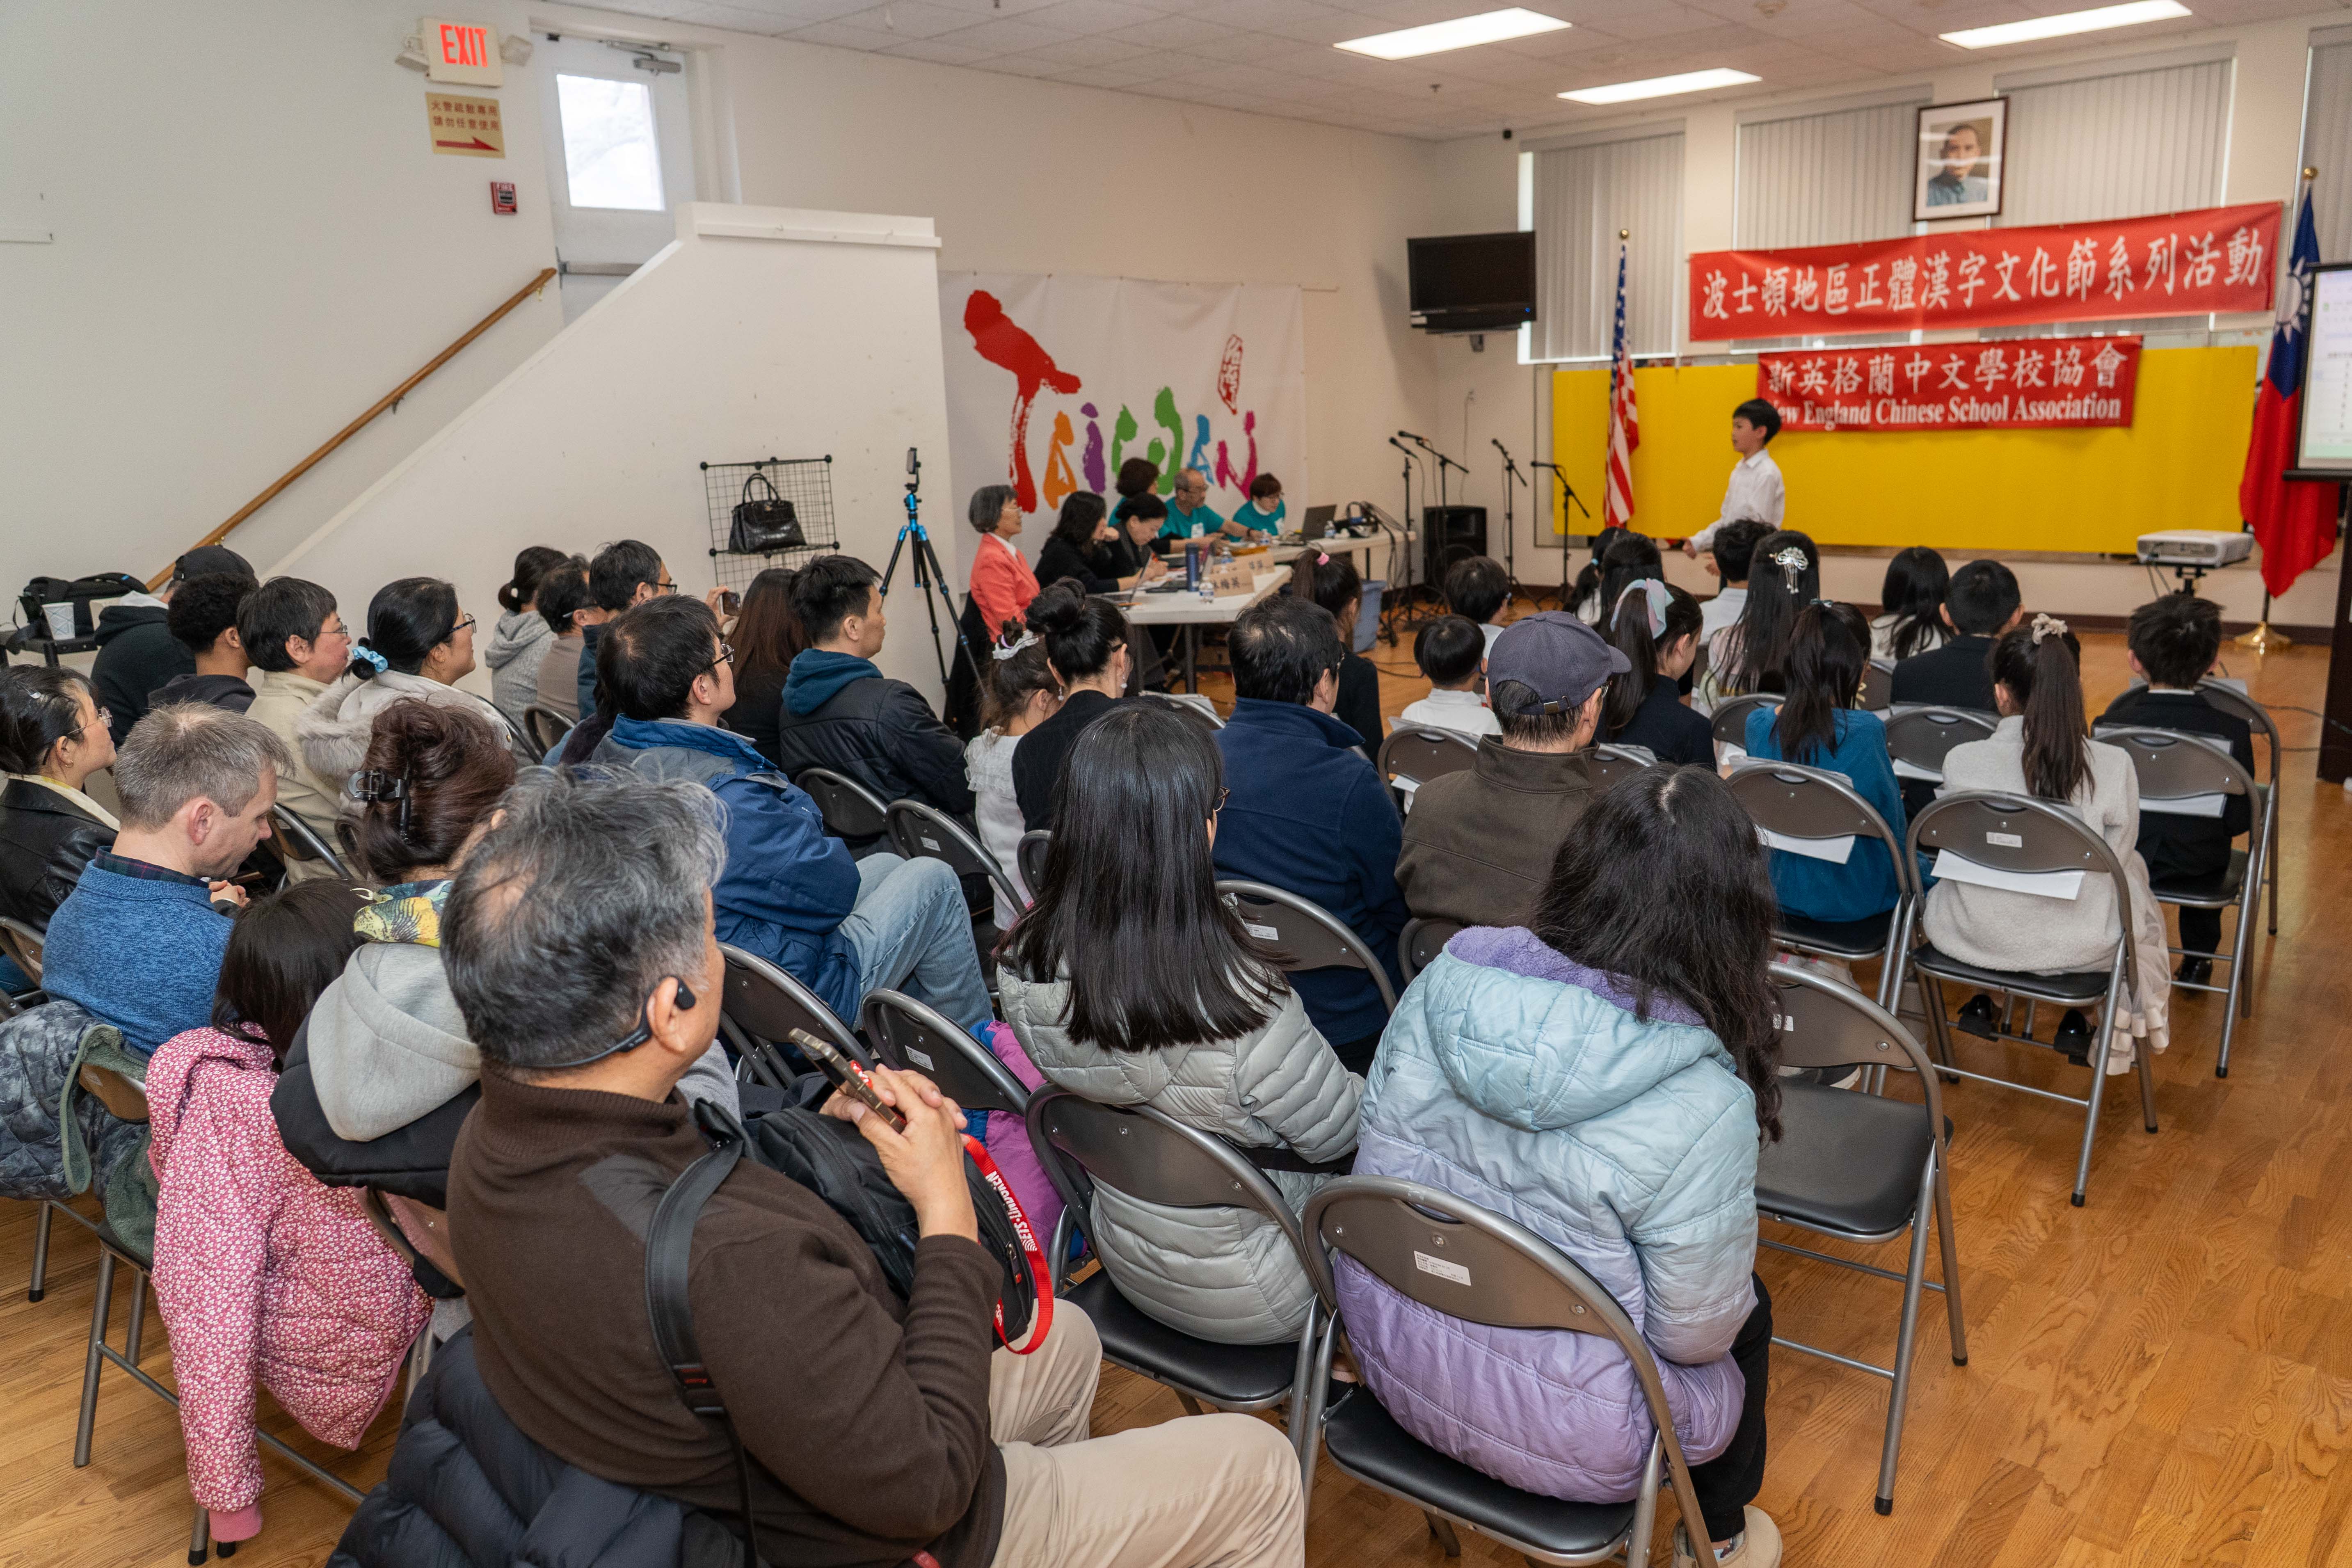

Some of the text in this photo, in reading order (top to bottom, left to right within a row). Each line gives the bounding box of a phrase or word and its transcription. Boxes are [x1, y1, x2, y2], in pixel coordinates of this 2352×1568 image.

[439, 24, 488, 68] EXIT
[1703, 226, 2264, 320] 波士頓地區正體漢字文化節系列活動
[1767, 342, 2128, 395] 新英格蘭中文學校協會
[964, 289, 1257, 514] TAIWAN
[1774, 392, 2121, 431] ew England Chinese School Association
